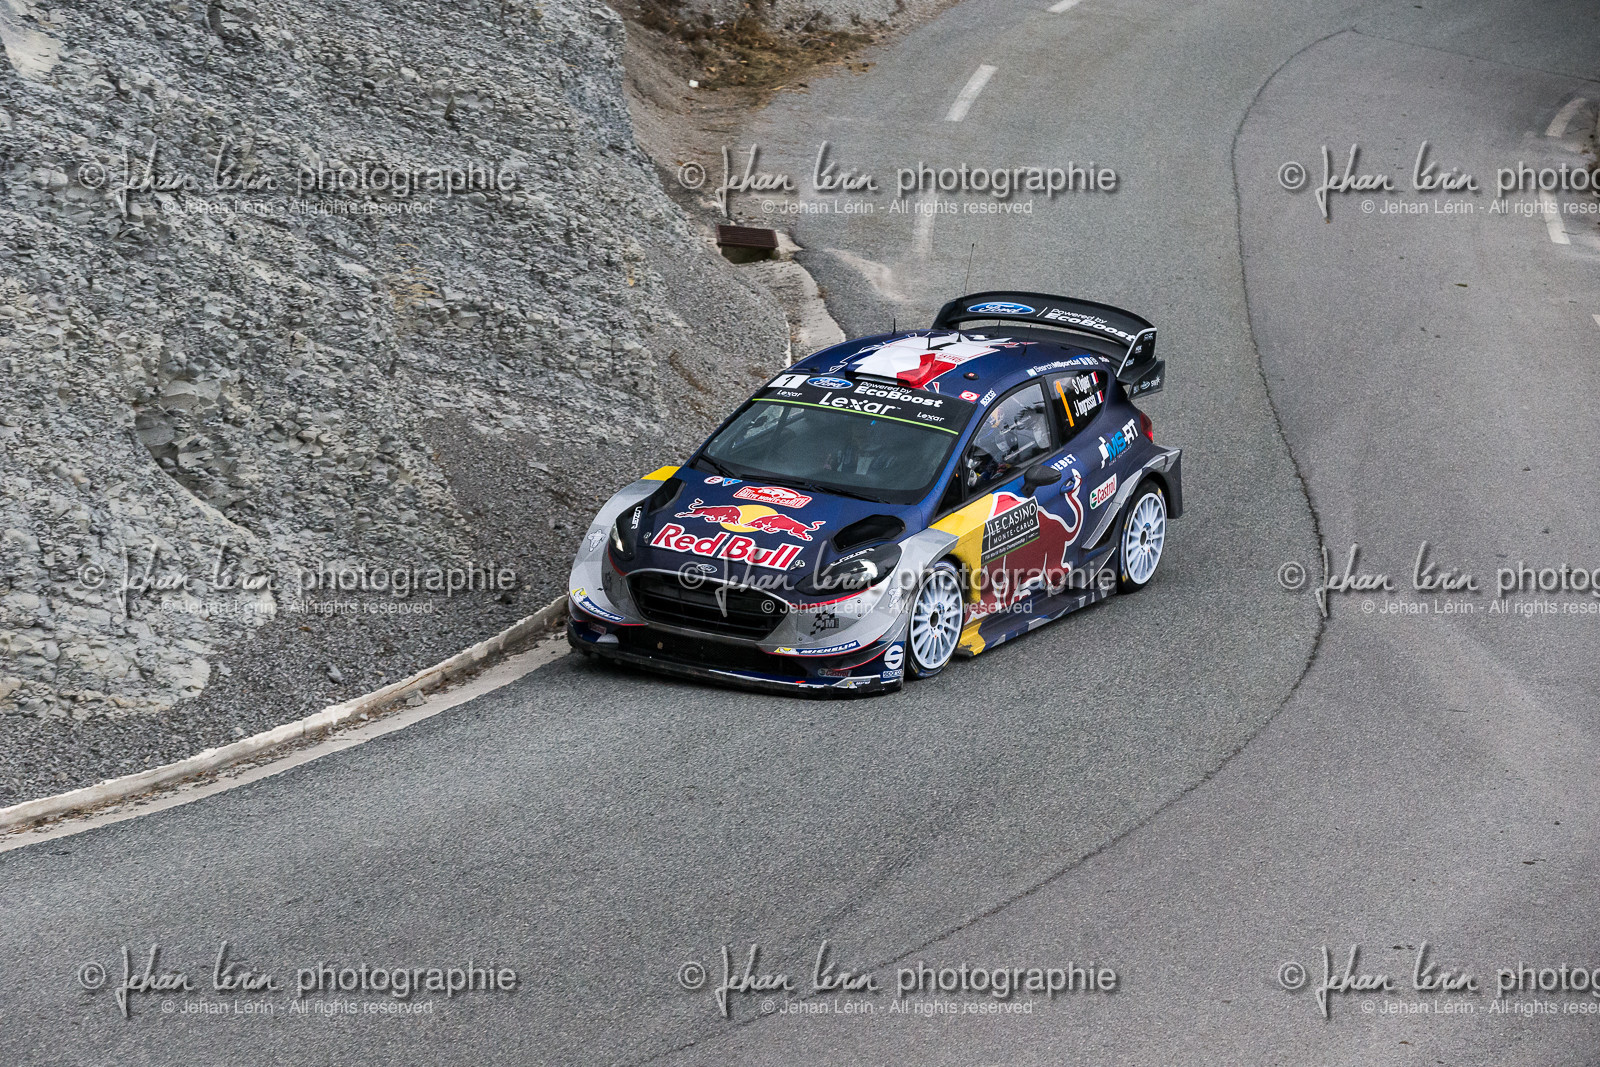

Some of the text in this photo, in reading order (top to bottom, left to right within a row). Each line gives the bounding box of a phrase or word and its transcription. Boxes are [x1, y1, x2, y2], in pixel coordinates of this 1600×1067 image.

[1051, 308, 1108, 324] Powered by
[1044, 312, 1136, 342] EcoBoost
[781, 375, 797, 387] 1
[860, 382, 898, 392] Powered
[776, 389, 802, 398] Lexar
[853, 386, 943, 408] EcoBoost
[818, 391, 897, 416] Lexar
[917, 411, 944, 422] Lexar
[1096, 477, 1116, 504] Castrol
[1001, 502, 1037, 530] CASINO
[650, 523, 804, 571] Red Bull
[800, 640, 857, 654] MICHELIN
